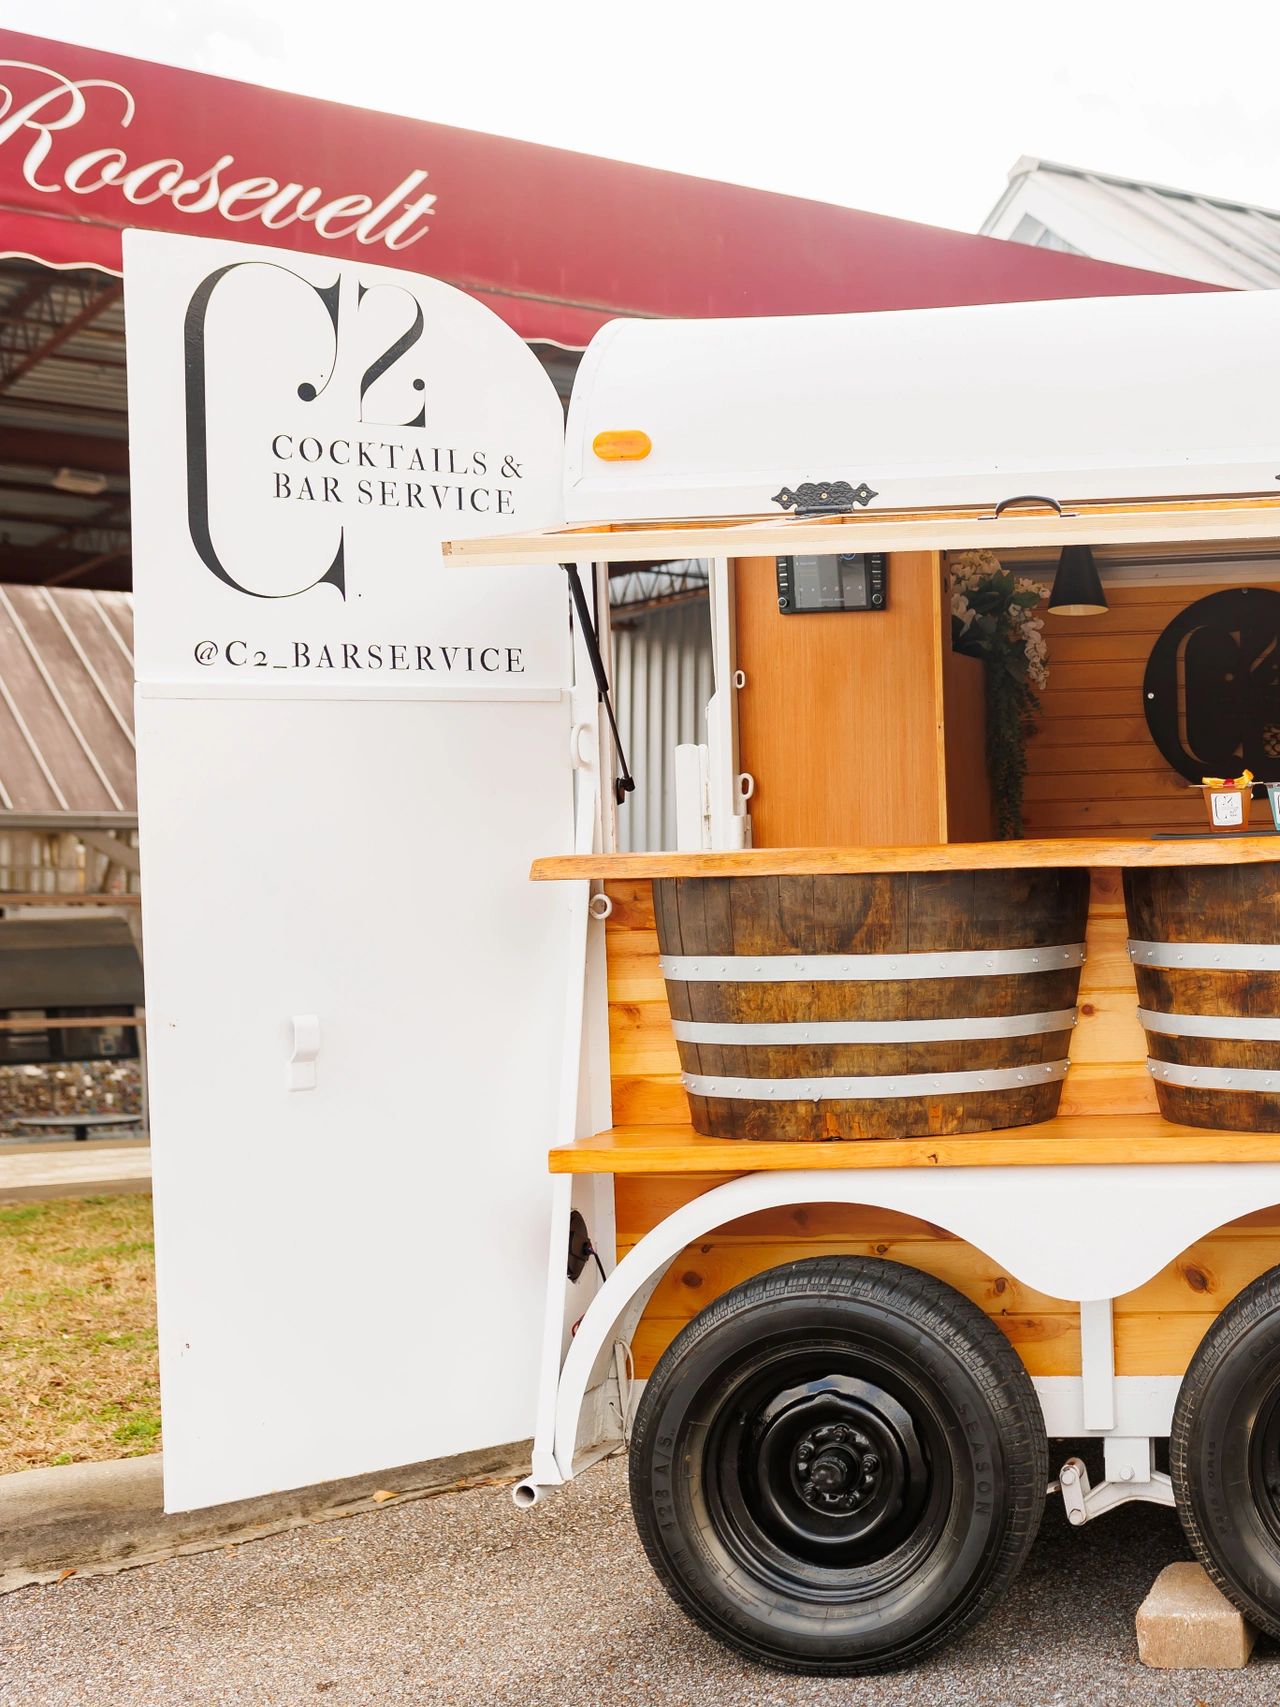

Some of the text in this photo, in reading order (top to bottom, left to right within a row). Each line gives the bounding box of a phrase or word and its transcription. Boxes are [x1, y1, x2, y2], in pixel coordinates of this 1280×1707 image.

[0, 59, 438, 251] Roosevelt
[271, 434, 524, 479] COCKTAILS &
[273, 472, 517, 515] BAR SERVICE
[193, 640, 526, 673] @C2_BARSERVICE
[956, 1401, 992, 1518] SEASON
